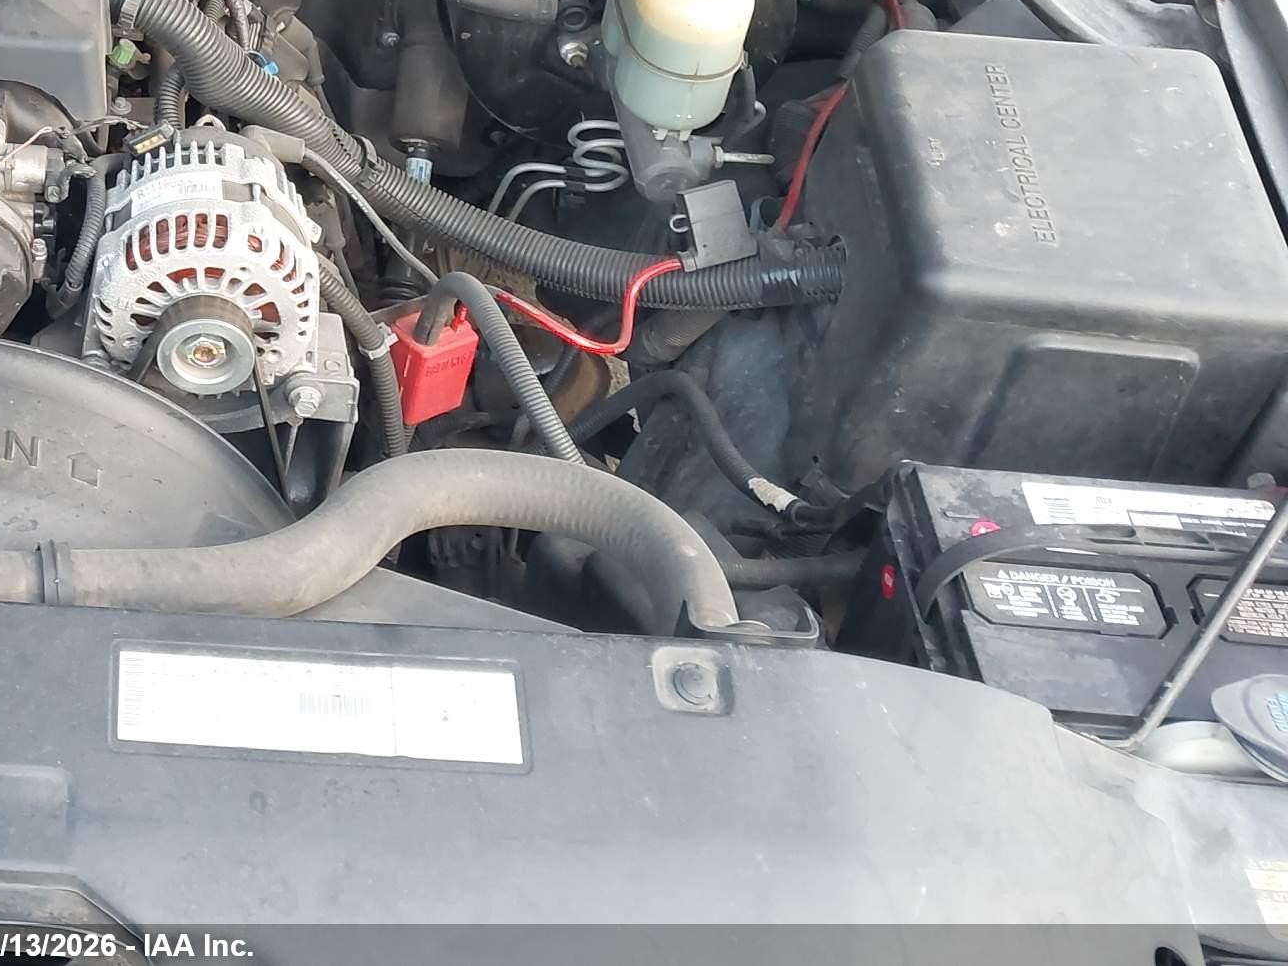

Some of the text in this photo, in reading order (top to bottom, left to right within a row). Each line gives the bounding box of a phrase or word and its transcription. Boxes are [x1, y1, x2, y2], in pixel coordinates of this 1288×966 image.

[984, 64, 1058, 247] ELECTRICAL CENTER
[1008, 570, 1060, 584] DANGER
[1069, 575, 1117, 588] POISON
